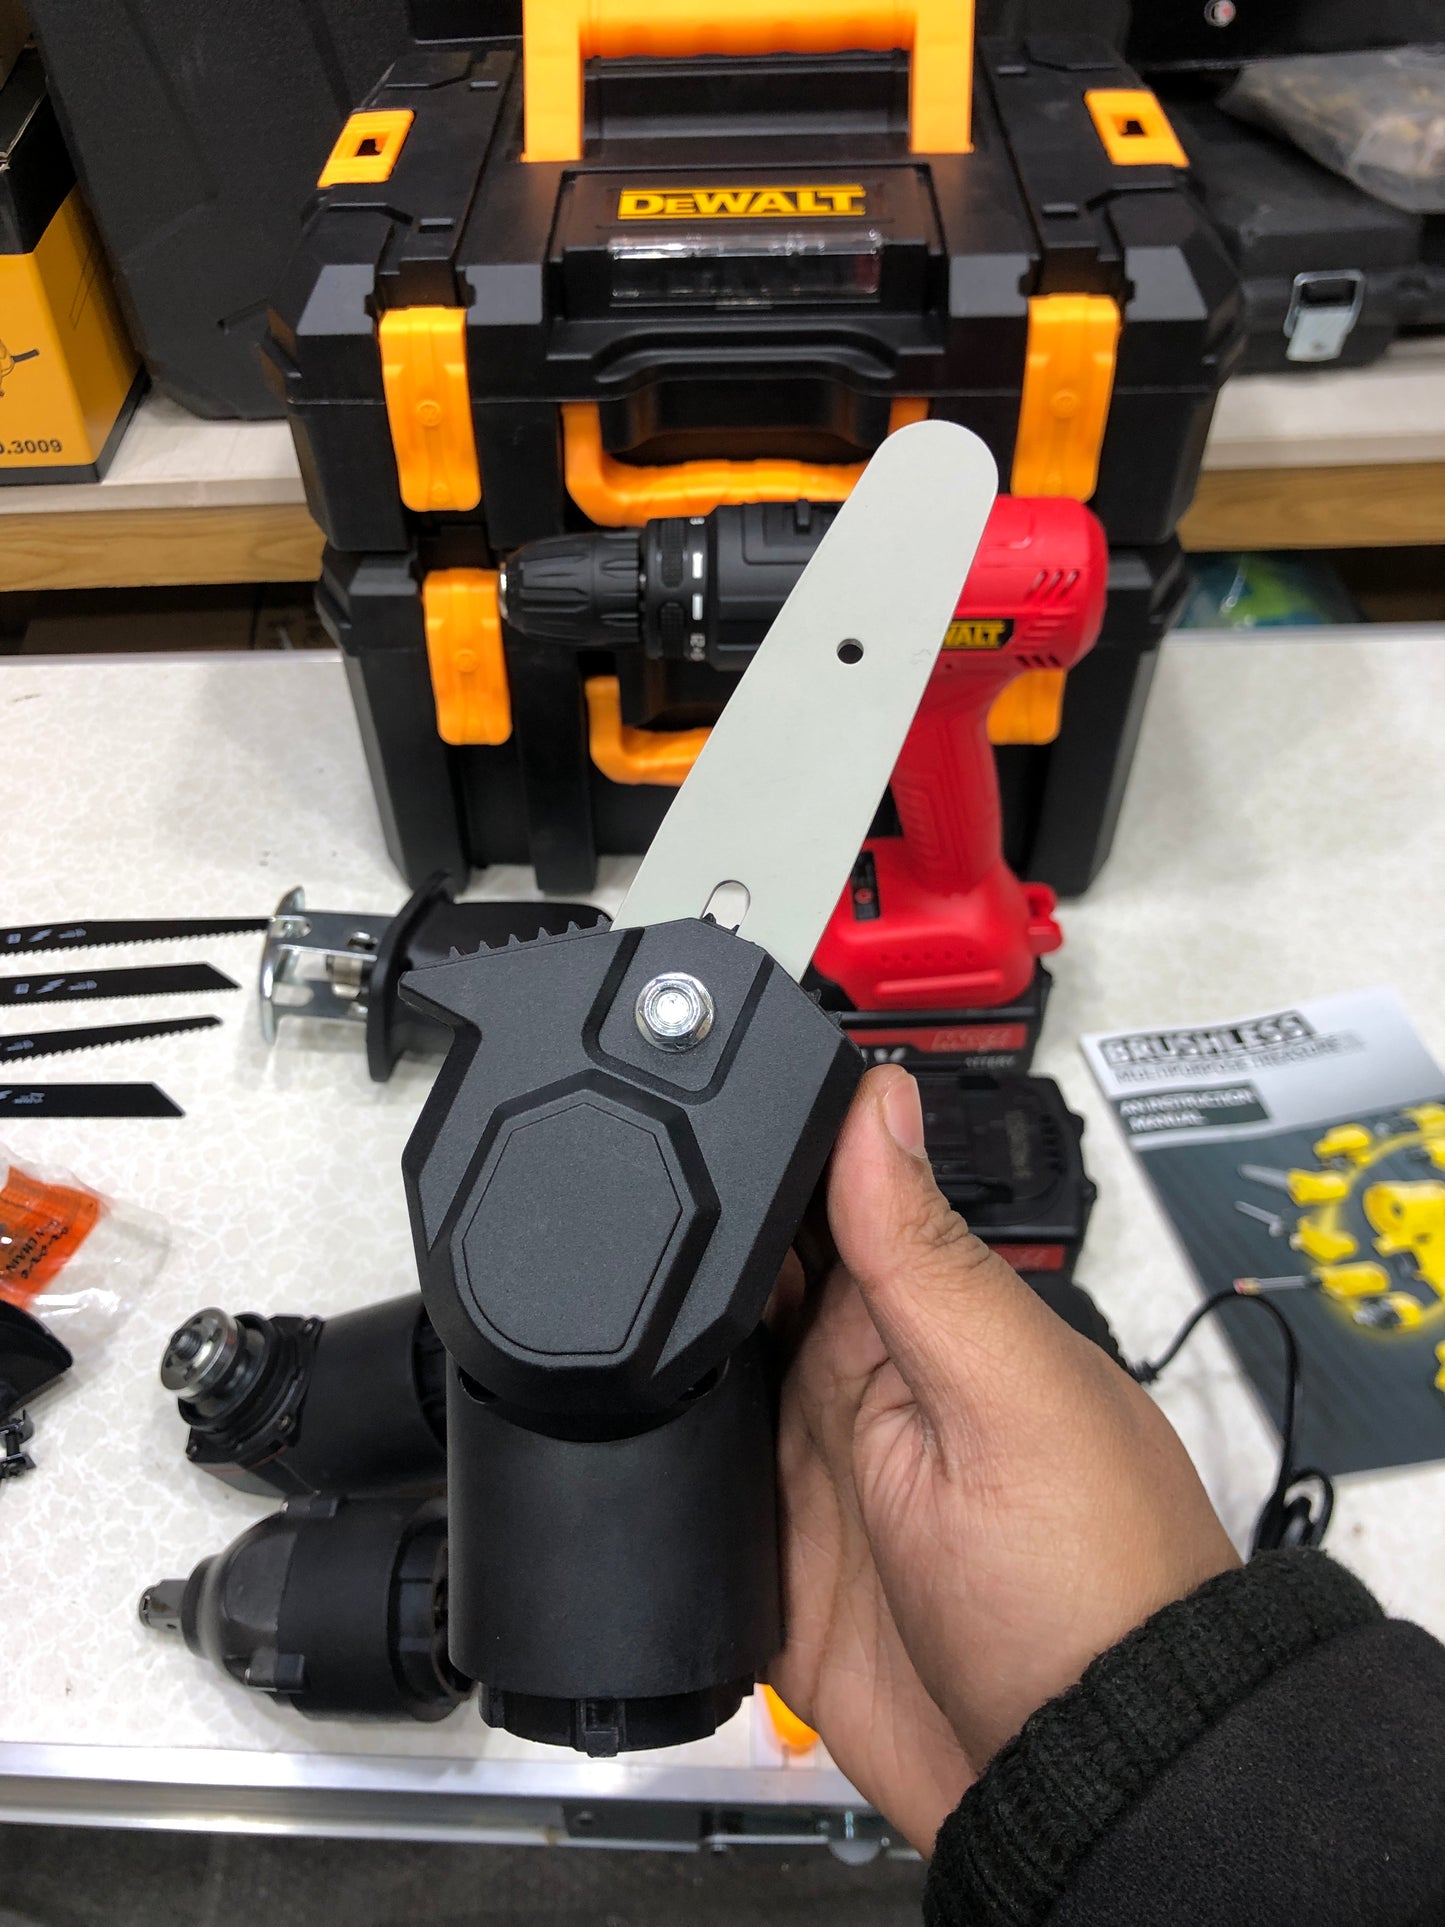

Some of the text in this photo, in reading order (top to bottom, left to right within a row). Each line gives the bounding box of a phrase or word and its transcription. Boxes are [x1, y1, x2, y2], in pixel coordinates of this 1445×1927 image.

[1104, 1013, 1306, 1064] BRUSHLESS
[1143, 1087, 1259, 1112] INSTRUCTION
[1127, 1109, 1205, 1133] MANUAL
